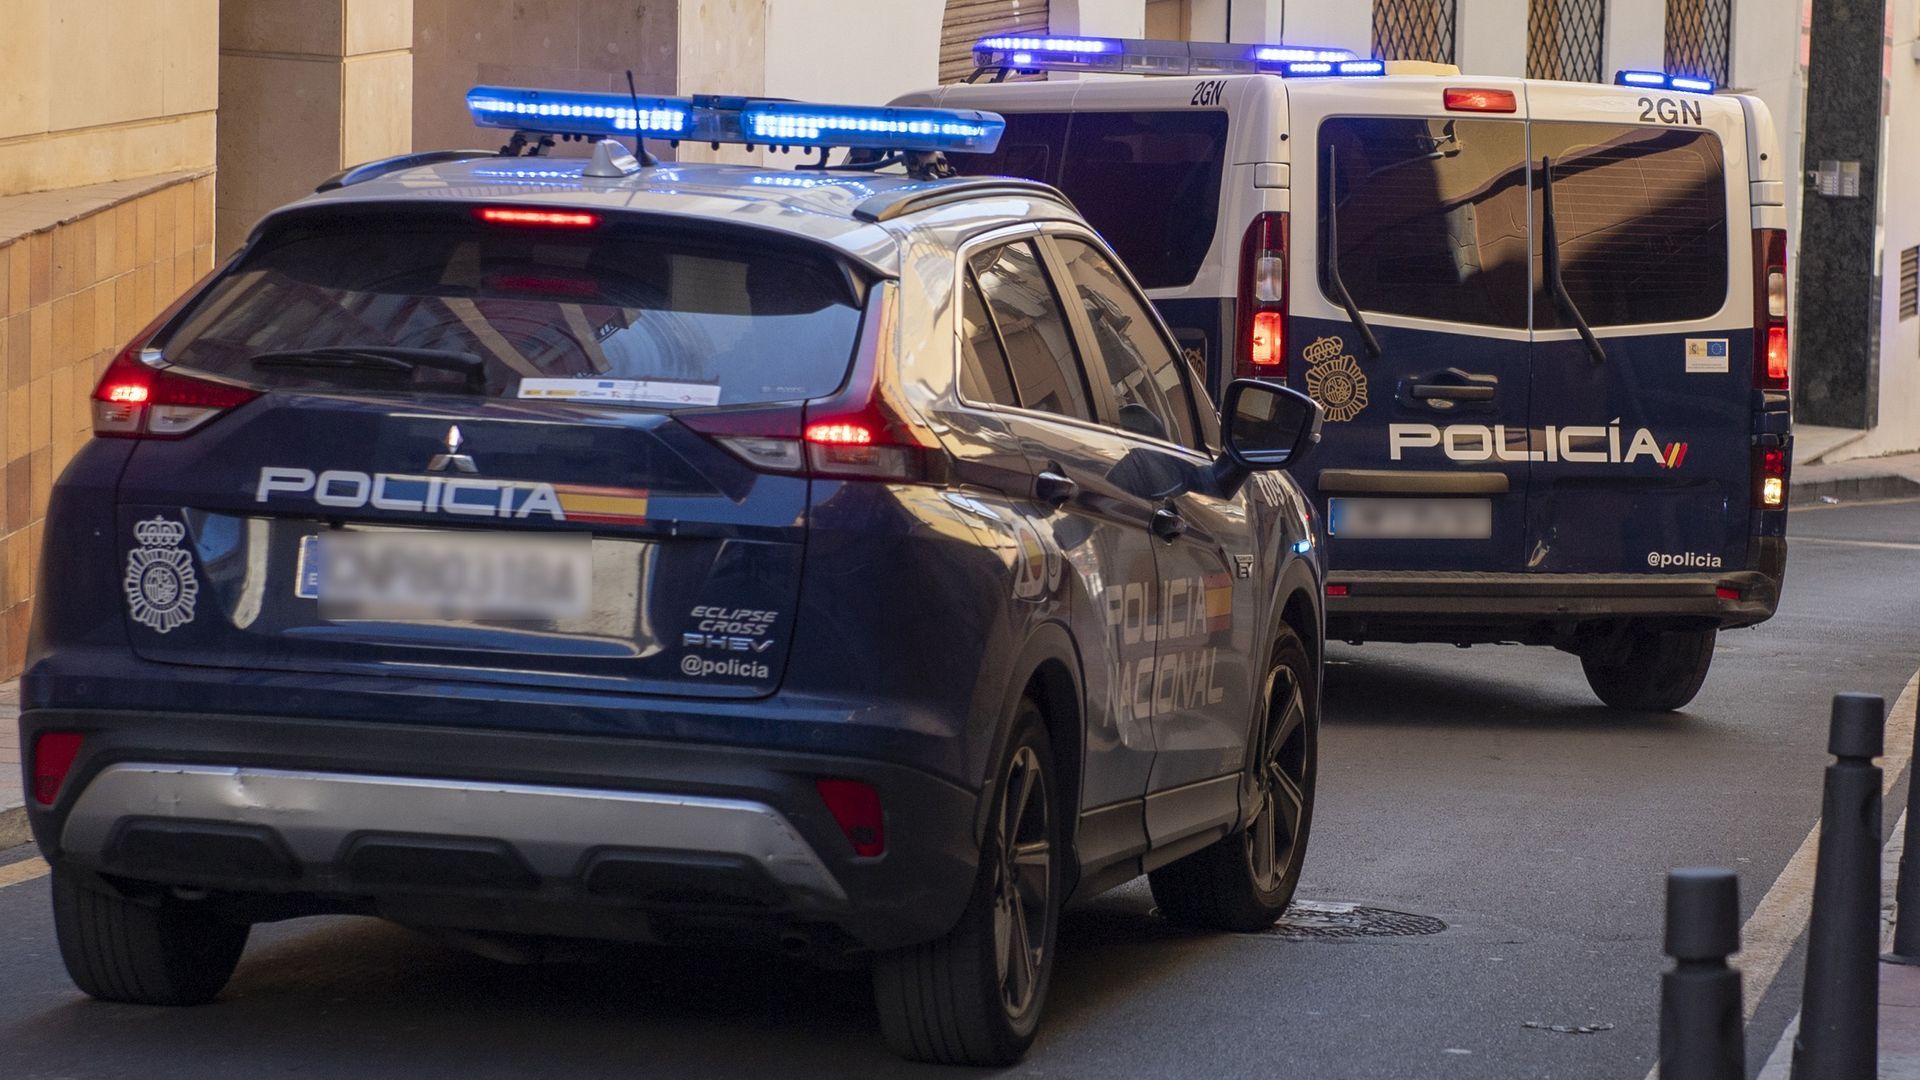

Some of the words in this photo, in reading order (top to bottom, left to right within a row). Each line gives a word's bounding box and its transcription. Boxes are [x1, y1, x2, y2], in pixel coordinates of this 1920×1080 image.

[1190, 80, 1228, 106] 2GN
[1637, 97, 1702, 126] 2GN
[1388, 416, 1667, 464] POLICÍA
[1647, 551, 1722, 568] @policia
[690, 605, 779, 623] ECLIPSE
[698, 619, 769, 635] CROSS
[682, 632, 774, 653] PHEV
[680, 654, 769, 678] @policia
[1103, 646, 1224, 728] NACIONAL
